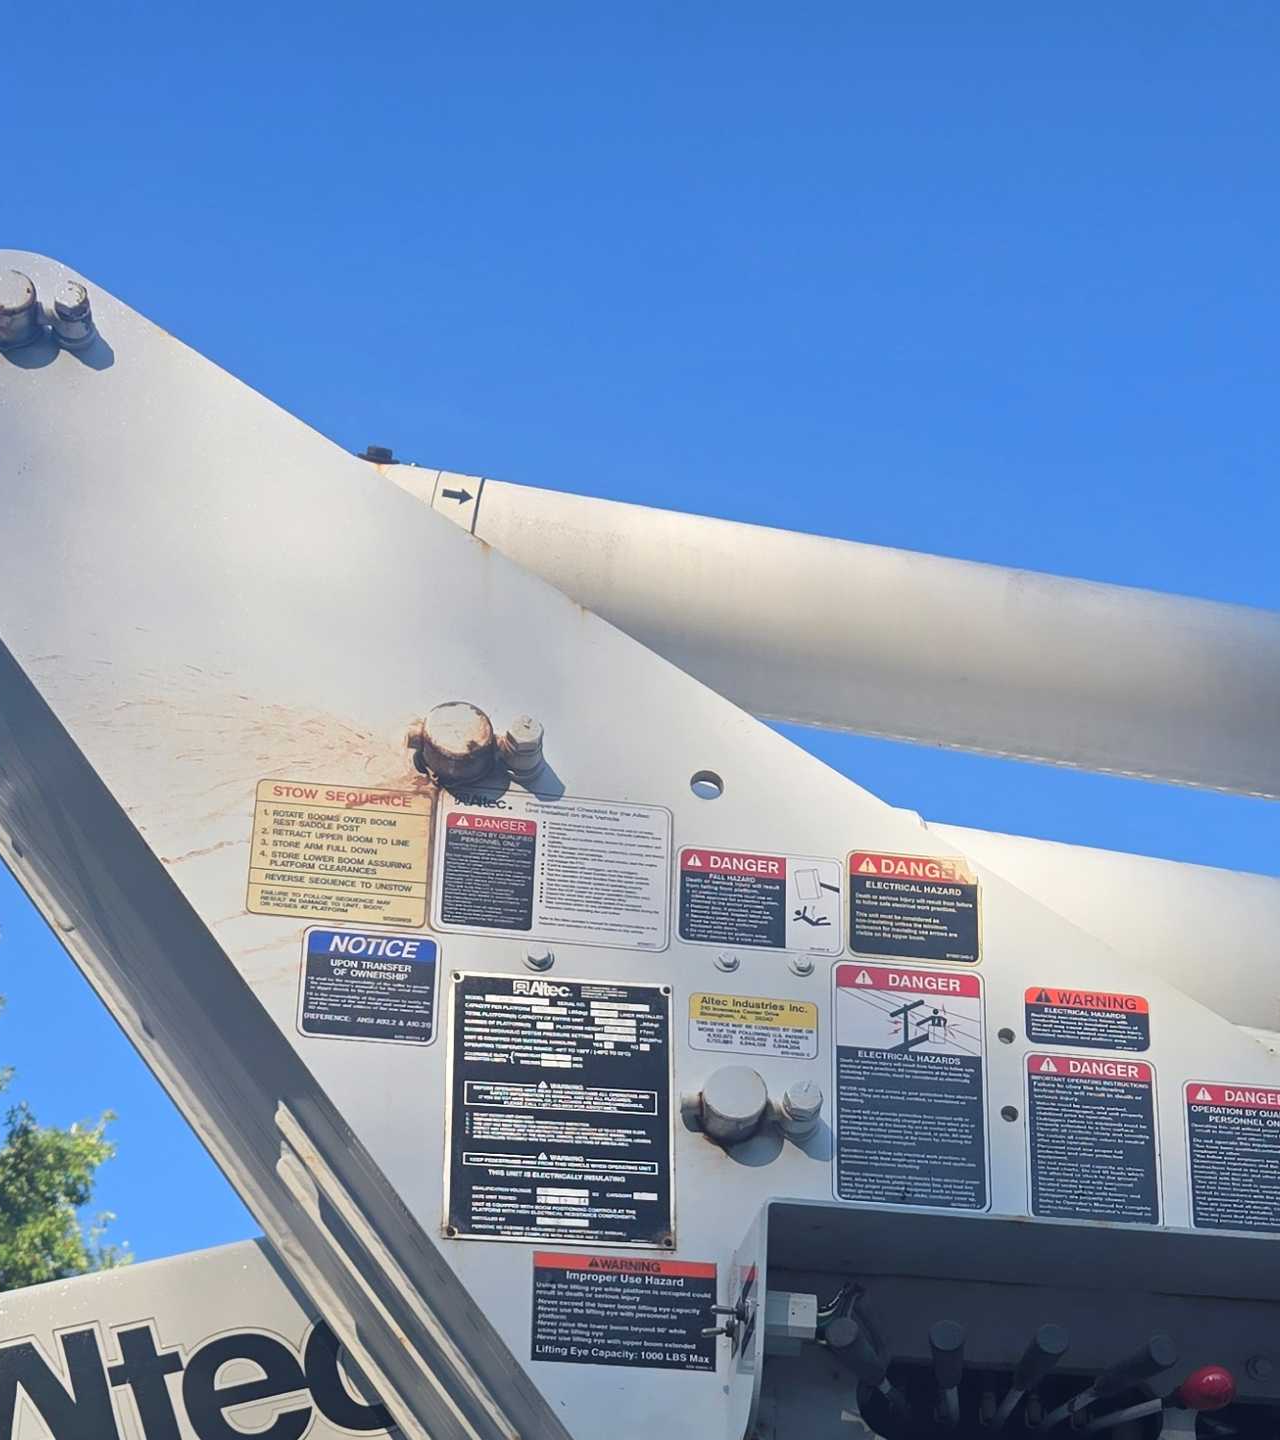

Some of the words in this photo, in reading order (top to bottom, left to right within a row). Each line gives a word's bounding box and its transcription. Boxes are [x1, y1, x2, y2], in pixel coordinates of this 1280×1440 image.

[273, 786, 318, 799] STOW
[326, 790, 412, 807] SEQUENCE
[273, 810, 303, 819] ROTATE
[308, 813, 340, 822] BOOMS
[344, 816, 366, 824] OVER
[370, 818, 396, 827] BOOM
[299, 822, 332, 830] SADDLE
[474, 818, 527, 831] DANGER
[273, 829, 312, 839] RETRACT
[316, 833, 343, 841] UPPER
[347, 835, 372, 843] BOOM
[272, 840, 300, 849] STORE
[304, 843, 323, 851] ARM
[327, 844, 347, 852] FULL
[351, 846, 377, 855] DOWN
[270, 861, 315, 871] PLATFORM
[319, 864, 376, 875] CLEARANCES
[272, 852, 299, 860] STORE
[304, 854, 334, 863] LOWER
[338, 857, 364, 866] BOOM
[368, 859, 412, 869] ASSURING
[710, 856, 779, 874] DANGER
[265, 873, 304, 883] REVERSE
[309, 877, 356, 887] SEQUENCE
[376, 882, 412, 892] UNSTOW
[866, 881, 921, 892] ELECTRICAL
[924, 886, 961, 896] HAZARD
[329, 935, 419, 958] NOTICE
[330, 959, 358, 968] UPON
[361, 962, 412, 972] TRANSFER
[351, 970, 408, 980] OWNERSHIP
[530, 983, 570, 996] Altec
[888, 974, 960, 992] DANGER
[700, 997, 728, 1008] Altec
[732, 1000, 784, 1012] Industries
[789, 1004, 807, 1014] Inc.
[1057, 992, 1136, 1010] WARNING
[1044, 1007, 1089, 1016] ELECTRICAL
[1091, 1011, 1126, 1019] HAZARDS
[858, 1050, 914, 1062] ELECTRICAL
[917, 1054, 961, 1065] HAZARDS
[1070, 1061, 1139, 1078] DANGER
[1191, 1105, 1242, 1116] OPERATION
[1209, 1116, 1264, 1126] PERSONNEL
[599, 1258, 661, 1272] WARNING
[566, 1271, 617, 1285] Improper
[620, 1274, 642, 1284] Use
[645, 1276, 684, 1287] Hazard
[536, 1345, 567, 1357] Lifting
[570, 1347, 589, 1358] Eye
[592, 1348, 638, 1361] Capacity:
[641, 1351, 664, 1361] 1000
[666, 1352, 686, 1362] LBS
[690, 1354, 709, 1363] Max
